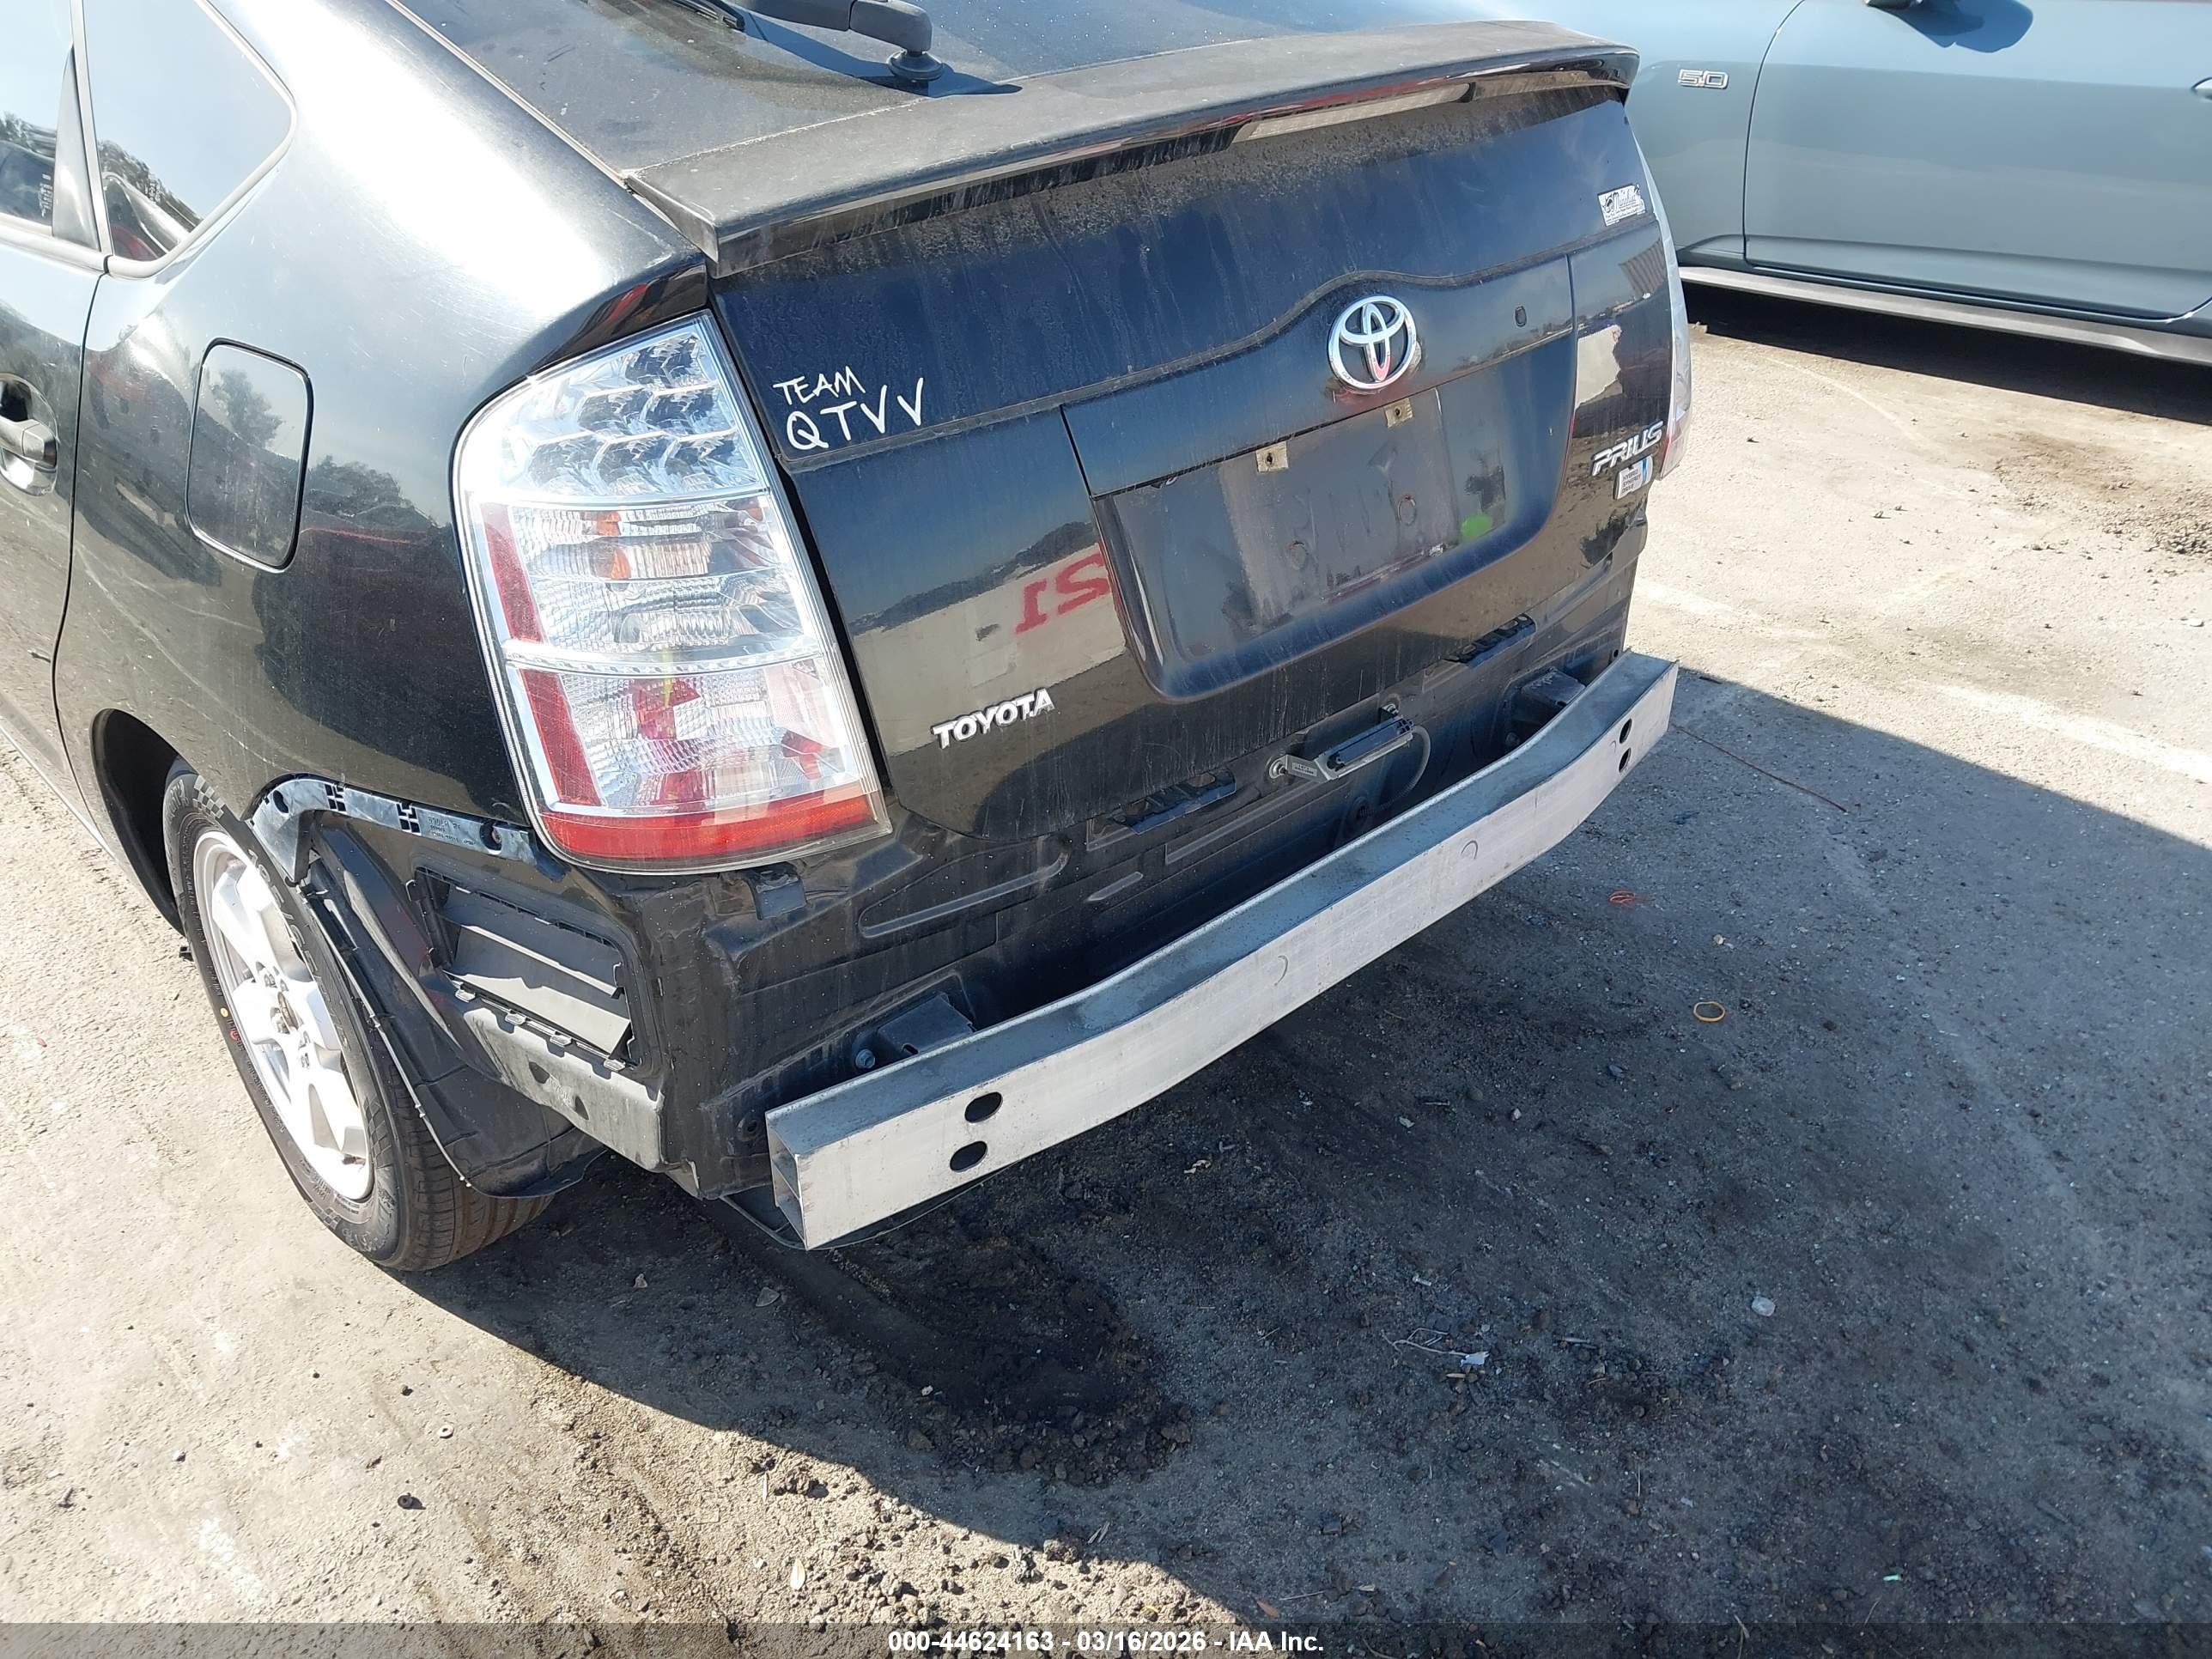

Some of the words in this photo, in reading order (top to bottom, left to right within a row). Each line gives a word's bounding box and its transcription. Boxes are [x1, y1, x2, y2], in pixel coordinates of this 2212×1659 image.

[772, 366, 866, 406] TEAM
[1591, 420, 1664, 477] PRIUS
[930, 688, 1058, 750] TOYOTA
